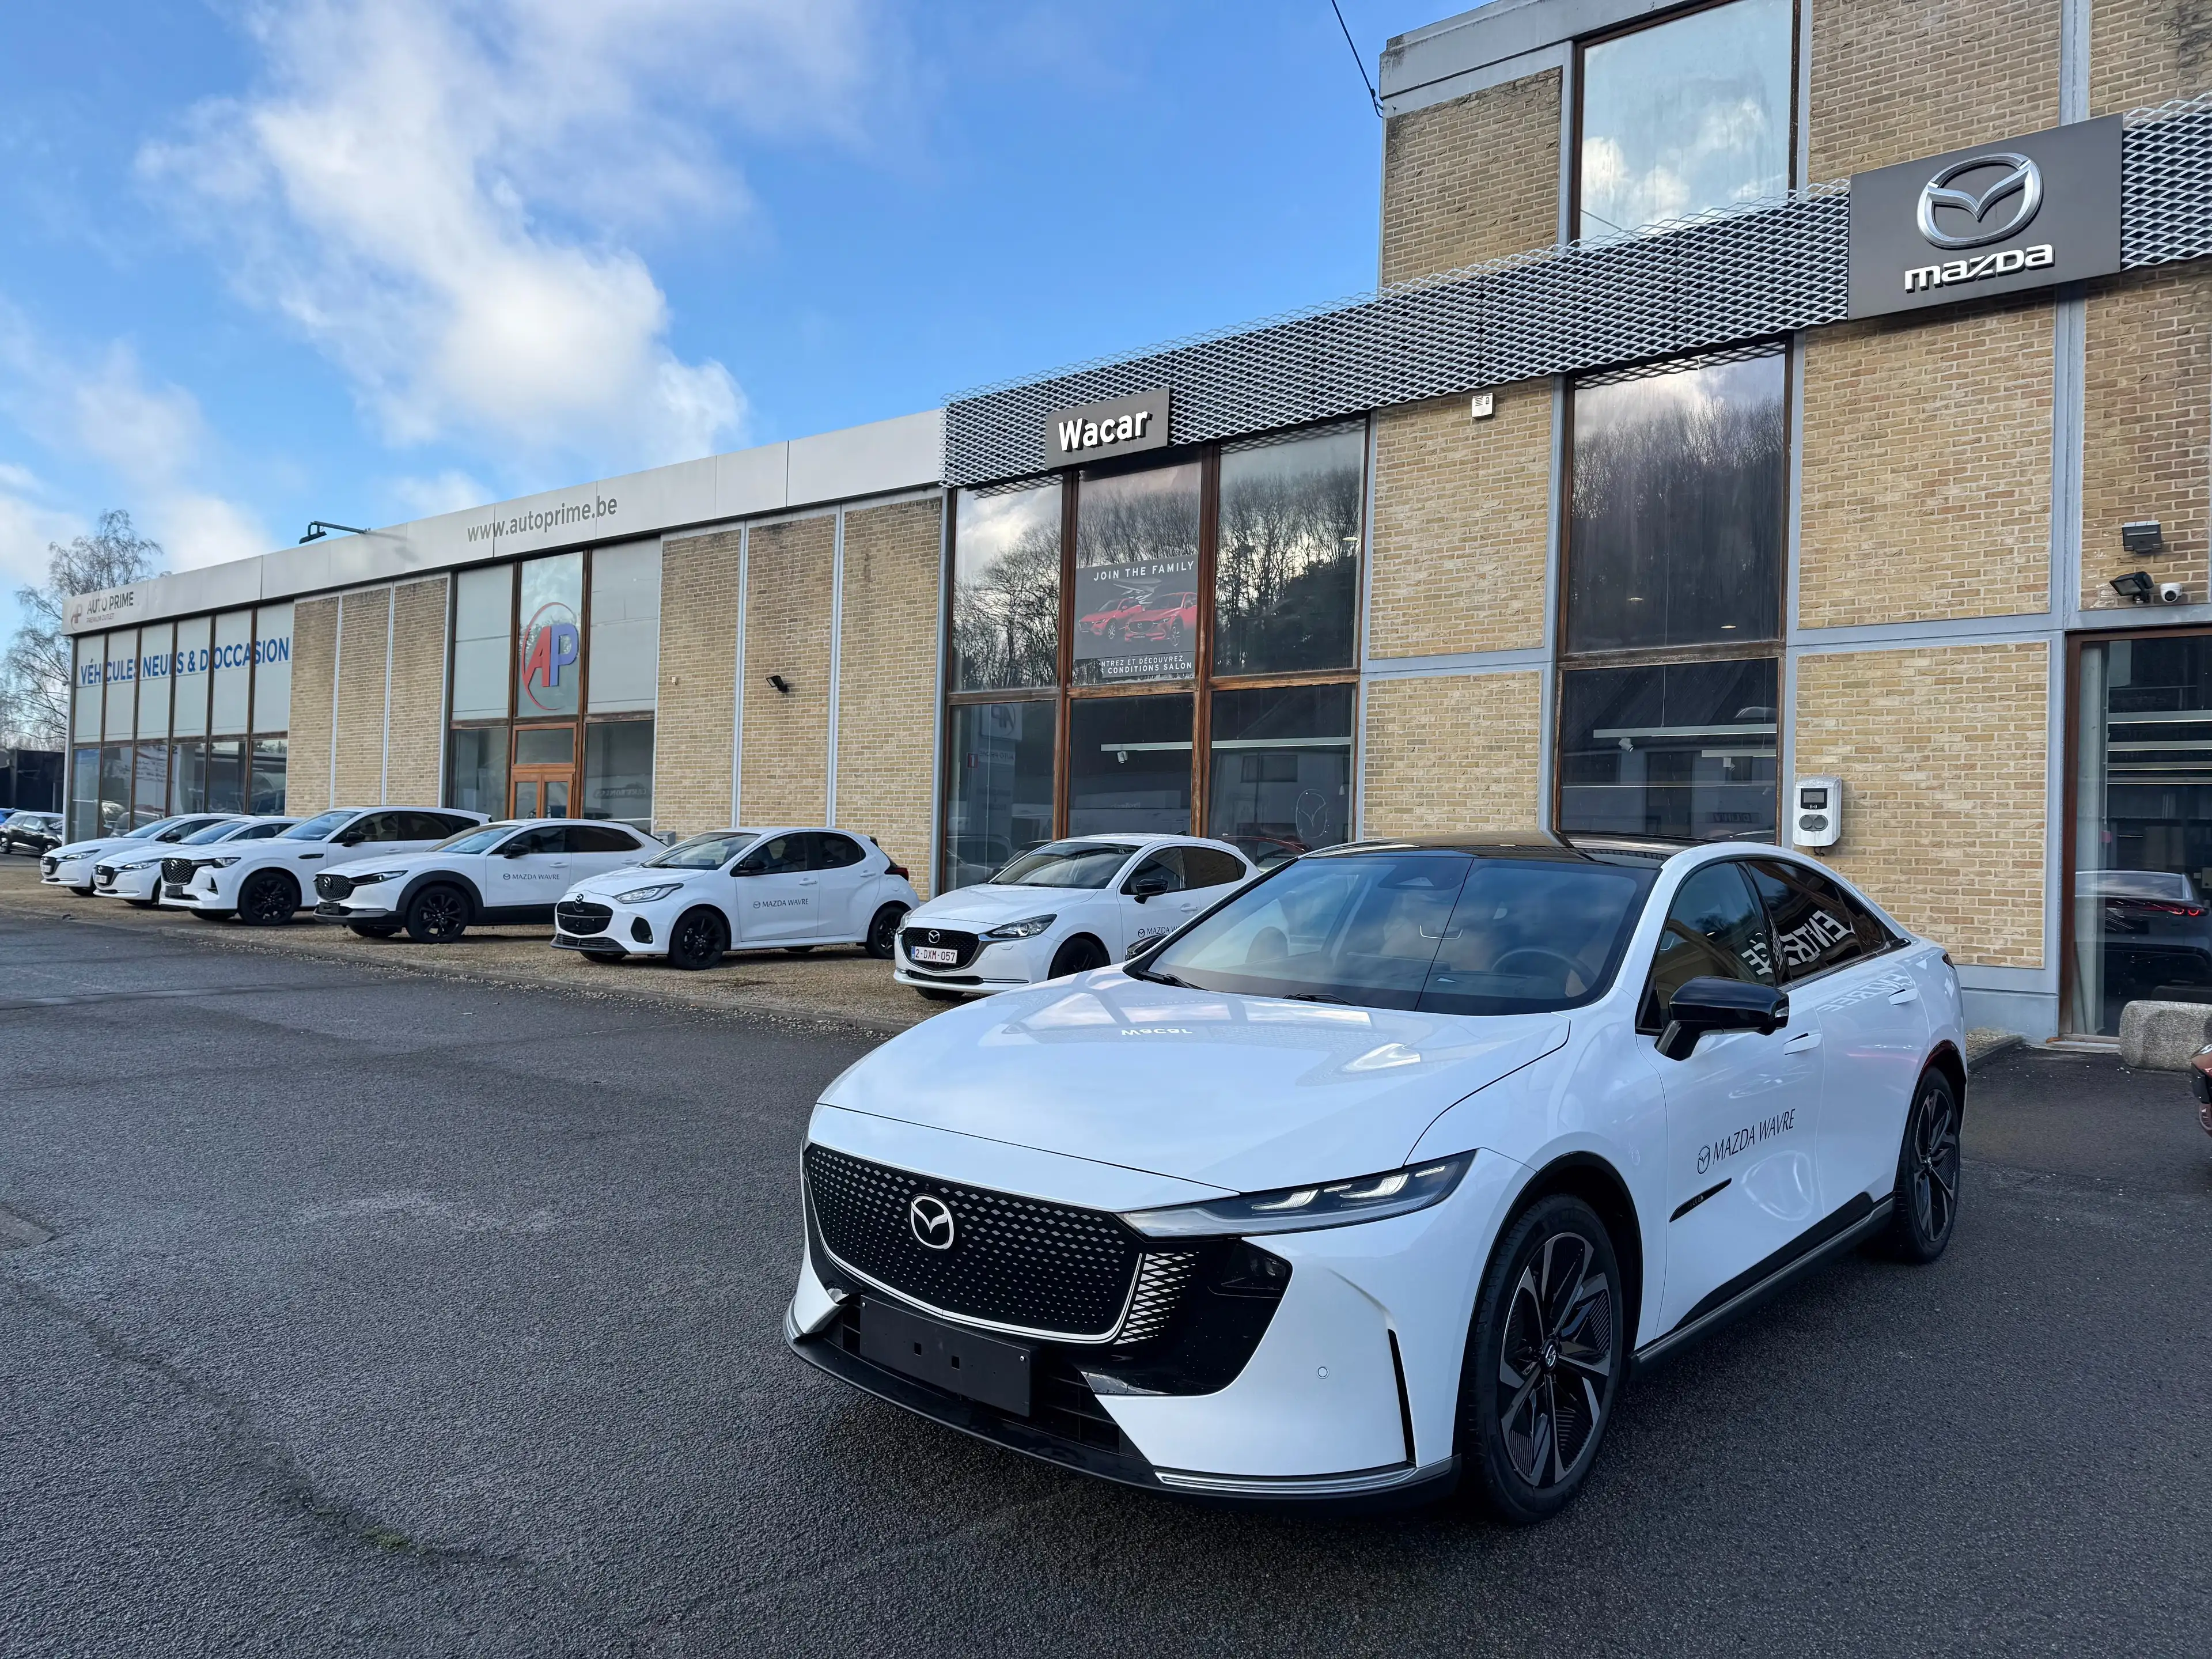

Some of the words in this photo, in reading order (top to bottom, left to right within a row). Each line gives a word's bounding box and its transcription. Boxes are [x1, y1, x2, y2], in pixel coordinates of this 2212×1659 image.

[1058, 411, 1153, 452] Wacar
[467, 495, 618, 542] www.autoprime.be
[1093, 570, 1119, 581] JOIN
[1125, 567, 1146, 577] THE
[1152, 561, 1194, 574] FAMILY
[87, 597, 108, 614] AUTO
[109, 591, 134, 611] PRIME
[187, 650, 196, 672] &
[200, 637, 289, 671] DOCCASION
[1139, 656, 1183, 664] DÉCOUVREZ
[1108, 664, 1160, 674] CONDITIONS
[1164, 662, 1192, 671] SALON
[1147, 926, 1170, 934] MAZDA
[1713, 1125, 1755, 1165] MAZDA
[1759, 1108, 1796, 1142] WAVRE
